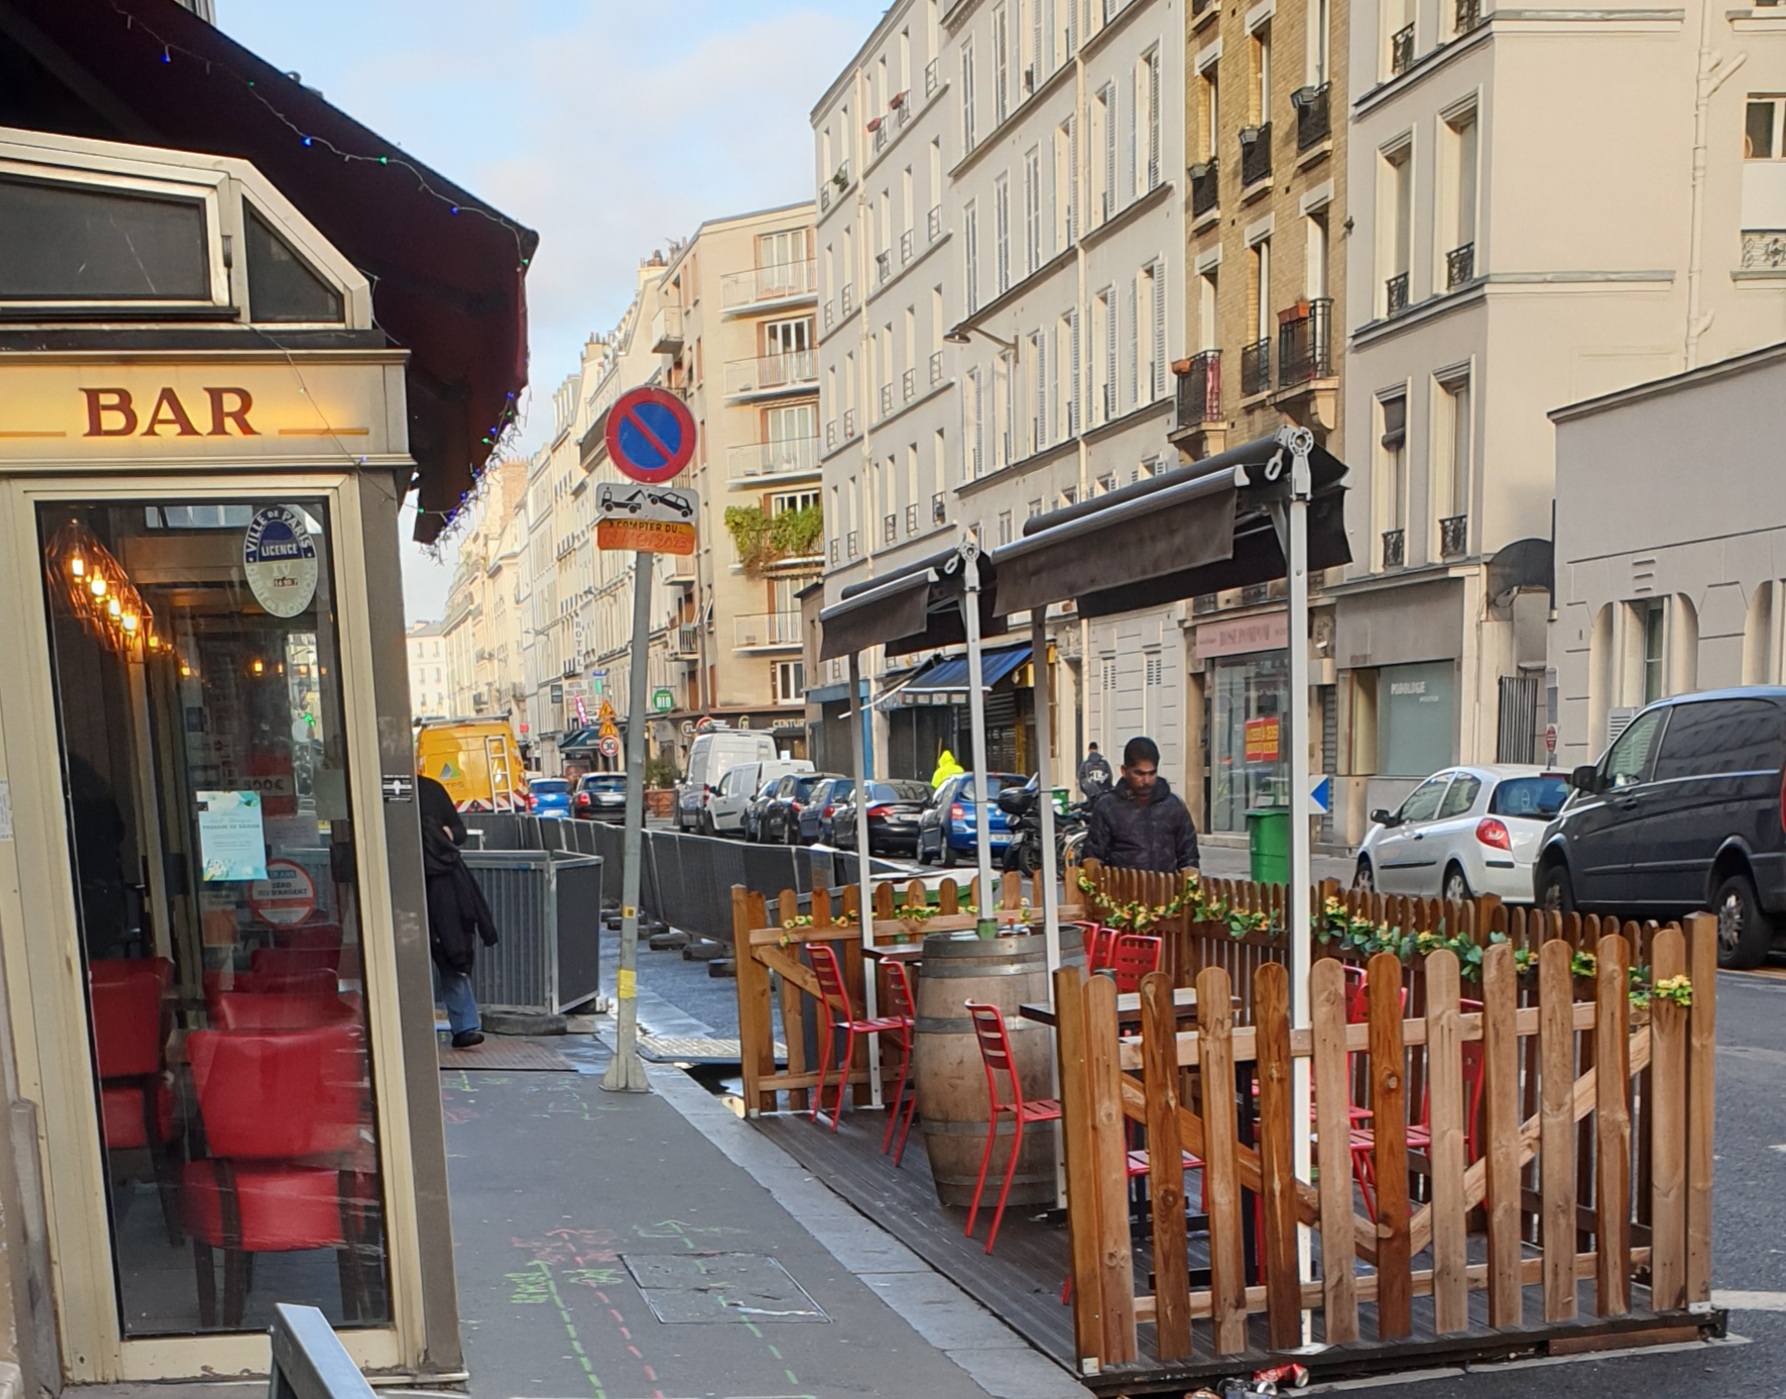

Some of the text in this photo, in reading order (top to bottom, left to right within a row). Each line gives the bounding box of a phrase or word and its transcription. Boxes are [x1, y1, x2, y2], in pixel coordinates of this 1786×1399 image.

[78, 387, 262, 436] BAR
[246, 510, 312, 553] VILLE DE PARIS
[261, 543, 298, 557] LICENCE
[271, 562, 291, 577] IV
[575, 620, 583, 667] HOTEL
[773, 718, 806, 728] CENTUR
[605, 742, 615, 750] 30
